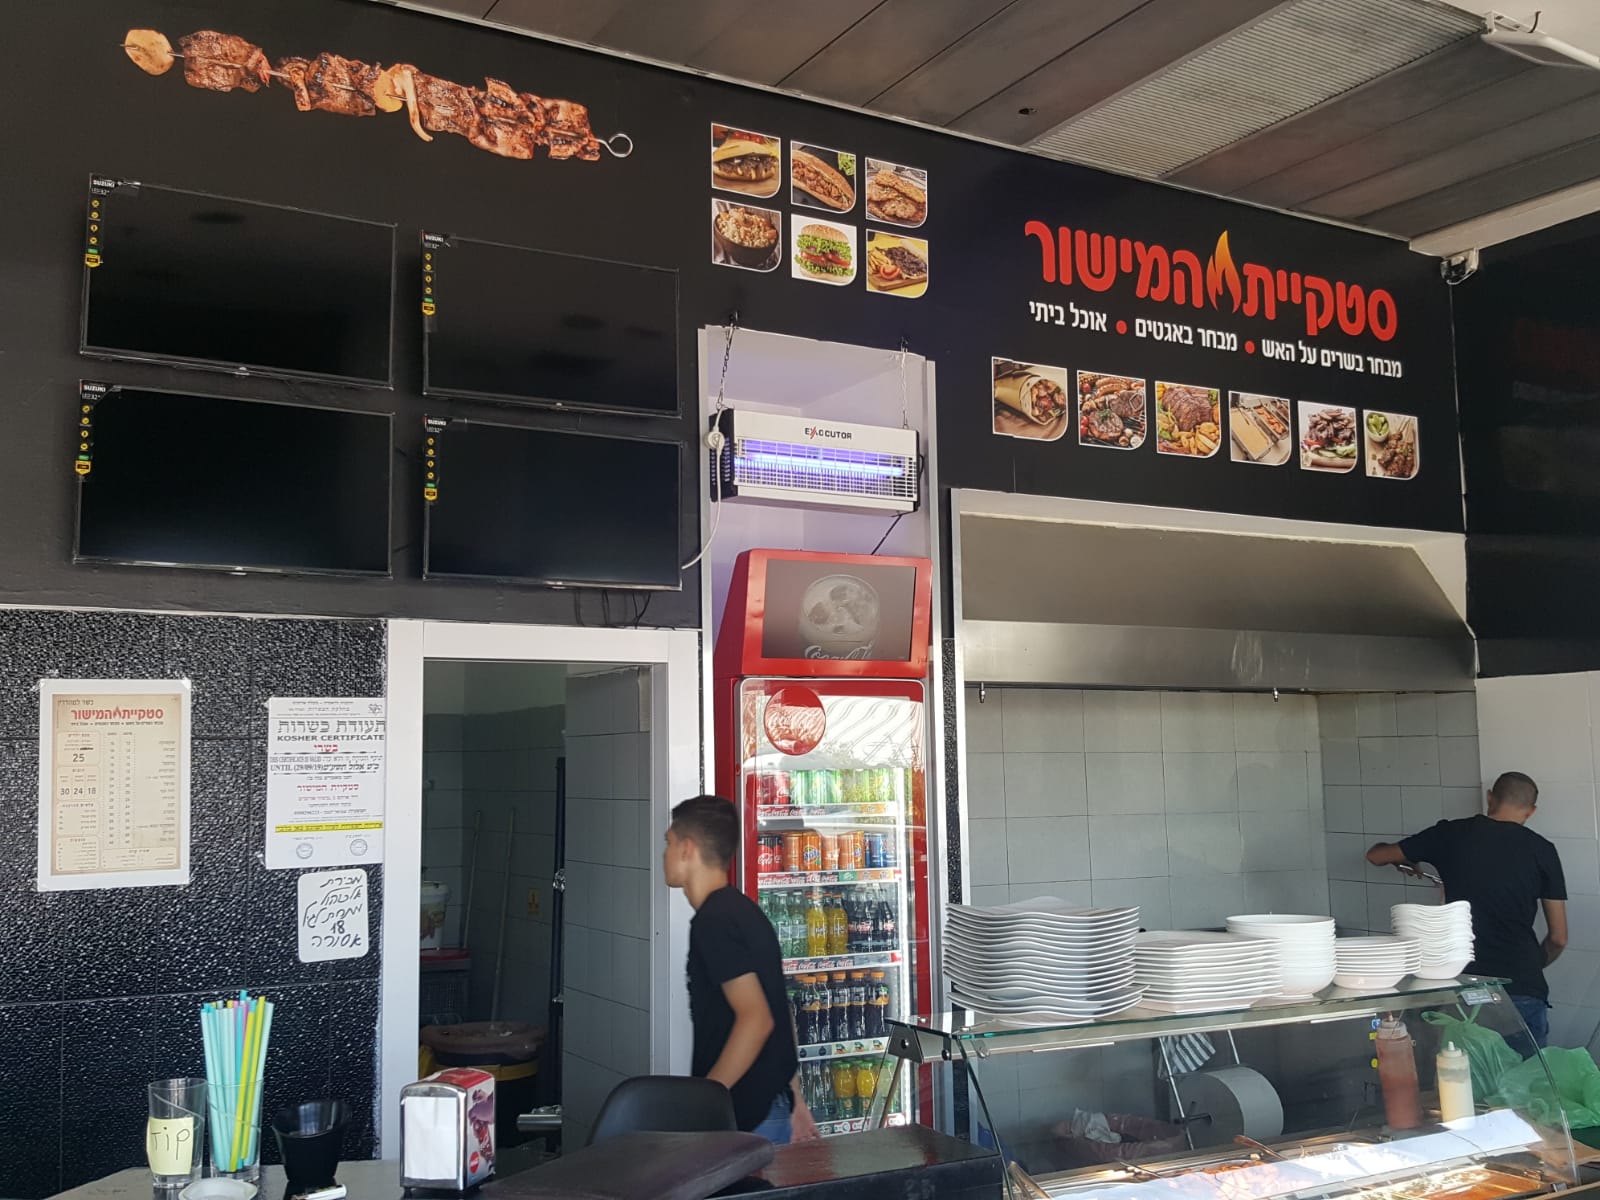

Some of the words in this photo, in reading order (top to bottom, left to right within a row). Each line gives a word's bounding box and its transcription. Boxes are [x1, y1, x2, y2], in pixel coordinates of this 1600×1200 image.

[93, 180, 115, 188] SUZUKI
[1025, 220, 1204, 309] המישור
[1029, 301, 1066, 325] ביתי
[1243, 263, 1398, 342] סטקיית
[1069, 302, 1107, 332] אוכל
[1135, 318, 1194, 345] באגטים
[1197, 328, 1238, 351] מבחר
[1262, 339, 1295, 362] האש
[1298, 340, 1317, 365] על
[1321, 349, 1364, 372] בשרים
[1367, 356, 1402, 378] מבחר
[83, 384, 106, 392] SUZUKI
[71, 709, 112, 720] המישור
[121, 708, 164, 720] סטקיית
[278, 720, 330, 733] כשרות
[72, 753, 85, 763] 25
[73, 787, 83, 795] 24
[330, 920, 345, 934] 18
